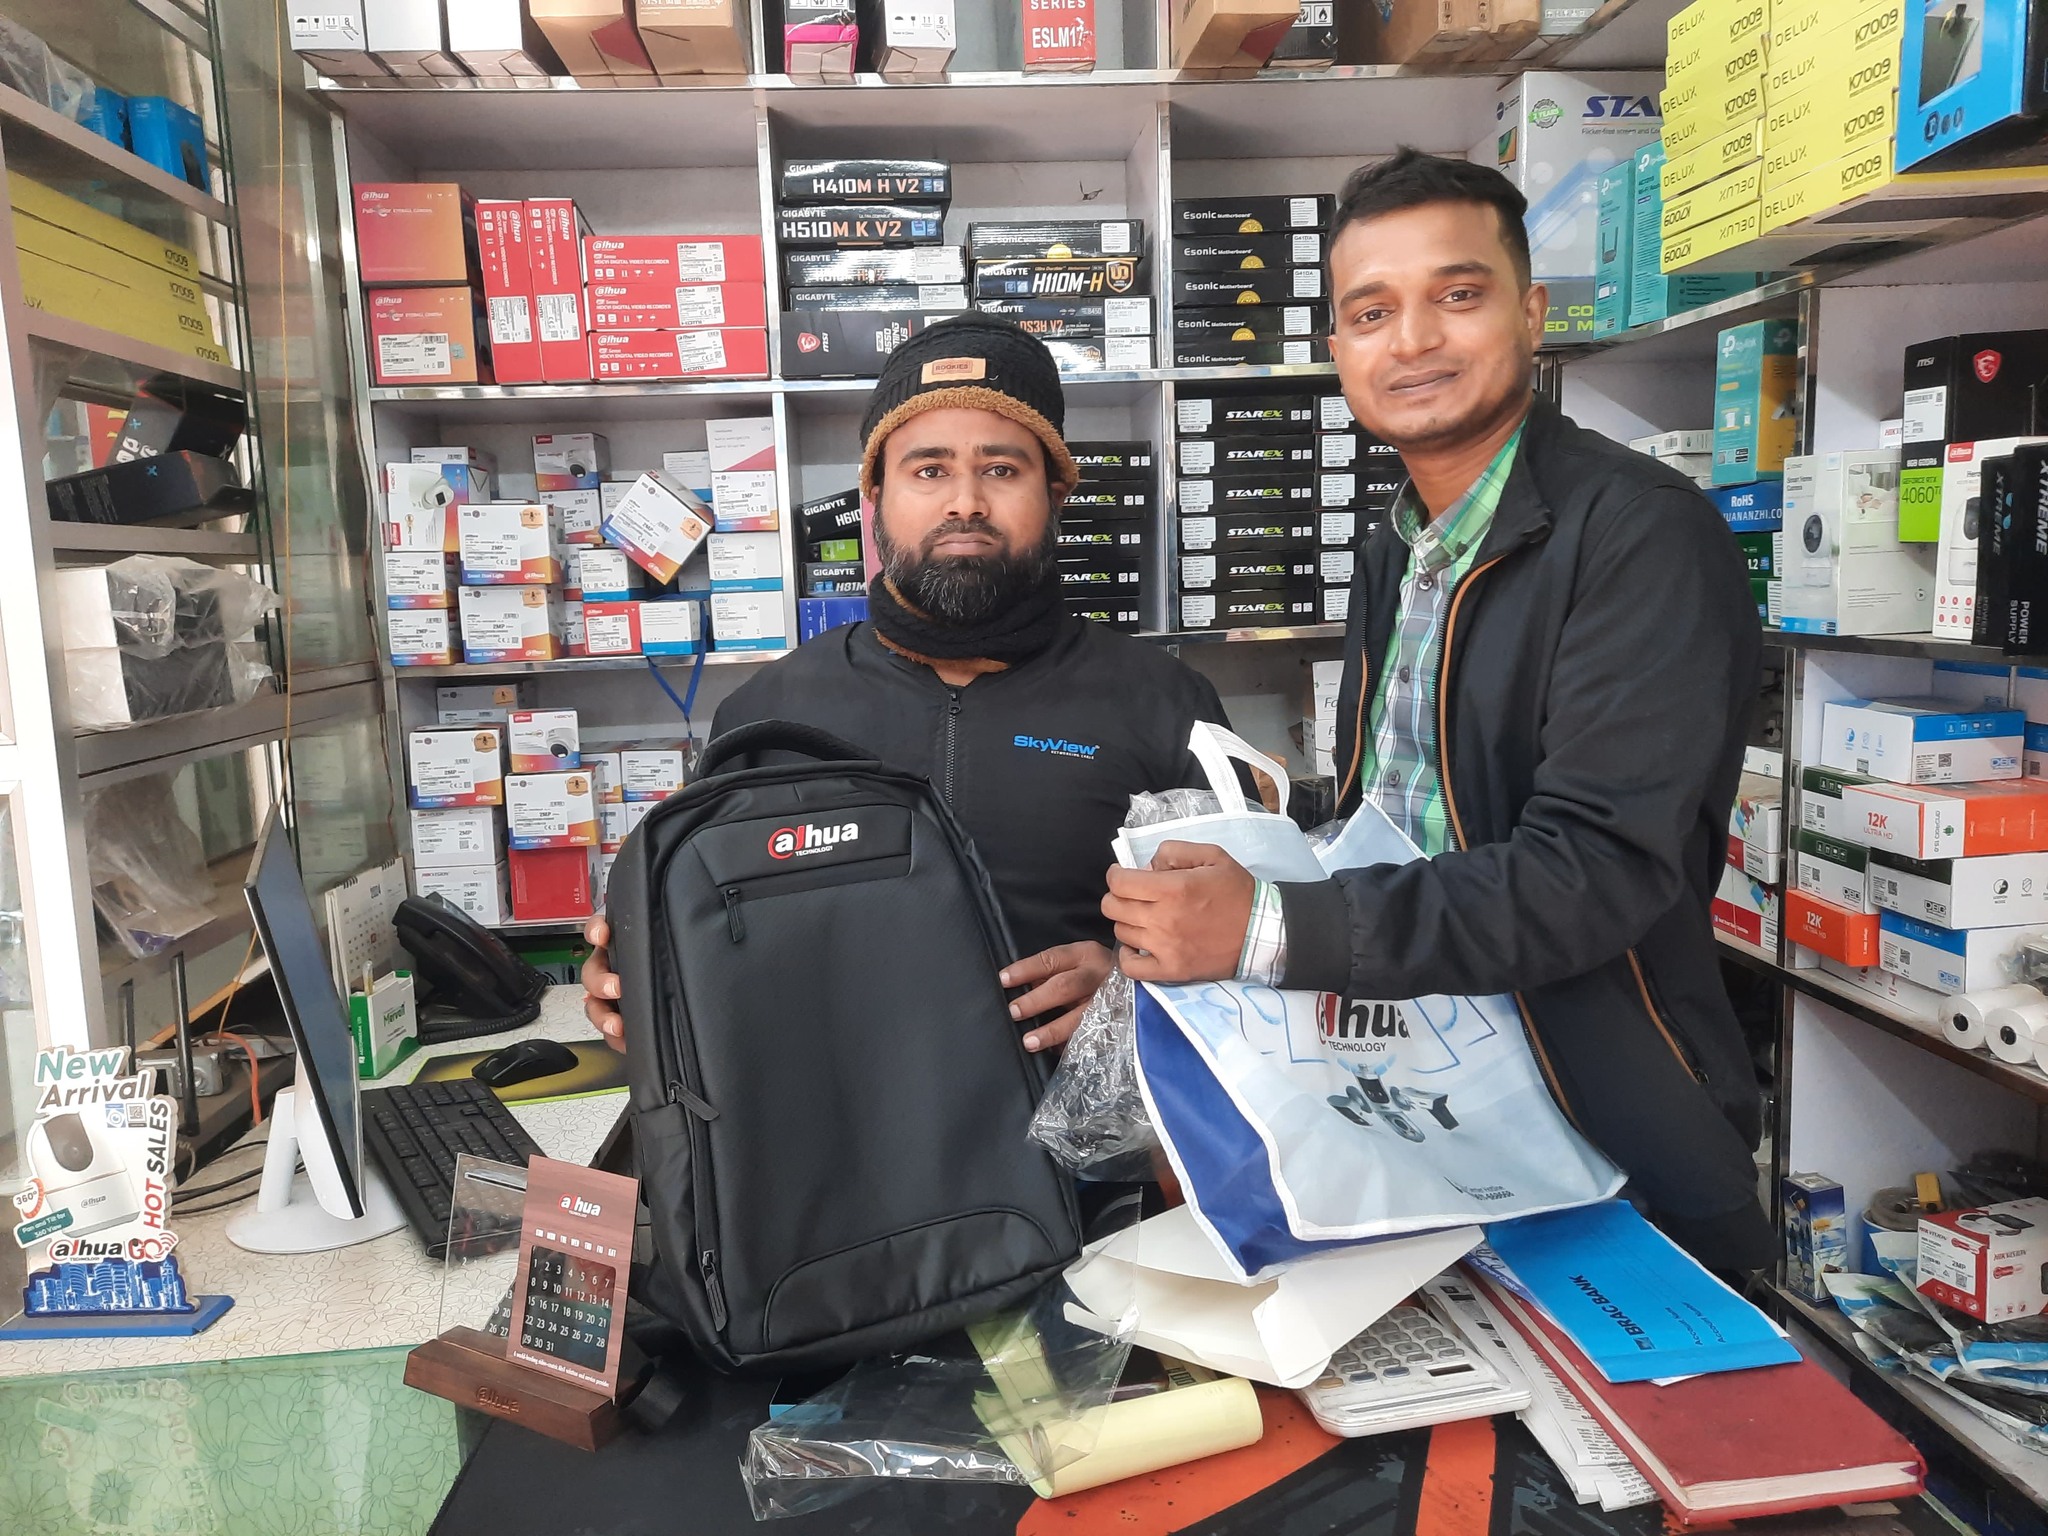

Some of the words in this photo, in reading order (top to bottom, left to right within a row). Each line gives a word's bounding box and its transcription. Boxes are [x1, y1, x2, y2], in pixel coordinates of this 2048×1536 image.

[1031, 0, 1085, 10] SERIES
[1671, 10, 1705, 40] DELUX
[1775, 11, 1819, 47] DELUX
[1667, 48, 1701, 78] DELUX
[1729, 7, 1763, 39] K7009
[1773, 56, 1816, 89] DELUX
[1855, 8, 1899, 44] K7009
[1663, 86, 1697, 114] DELUX
[1725, 49, 1758, 77] K7009
[1770, 101, 1811, 132] DELUX
[1849, 58, 1891, 91] K7009
[1582, 96, 1662, 117] STA
[1664, 122, 1697, 148] DELUX
[1724, 88, 1757, 116] K7009
[1767, 145, 1808, 174] DELUX
[1844, 105, 1885, 137] K7009
[1664, 164, 1695, 187] DELUX
[1722, 132, 1752, 157] K7009
[813, 179, 871, 193] H410M
[878, 179, 890, 193] H
[896, 179, 919, 193] V2
[1719, 175, 1755, 201] DELUX
[1764, 191, 1805, 218] DELUX
[1841, 155, 1882, 184] K7009
[782, 210, 826, 218] GIGABYTE
[1183, 211, 1216, 219] Esonic
[1664, 205, 1692, 227] K7009
[782, 221, 848, 238] H510M
[856, 221, 868, 237] K
[875, 221, 901, 237] V2
[1719, 215, 1755, 240] DELUX
[791, 254, 831, 262] GIGABYTE
[1184, 248, 1217, 256] Esonic
[1664, 242, 1692, 264] K7009
[984, 268, 1028, 276] GIGABYTE
[1032, 272, 1104, 292] H110M-H
[1185, 282, 1218, 290] Esonic
[796, 293, 836, 301] GIGABYTE
[981, 305, 1024, 313] GIGABYTE
[1020, 320, 1047, 333] DS3H
[1050, 320, 1063, 332] V2
[1178, 320, 1210, 328] Esonic
[935, 363, 968, 371] ROOKIES
[1178, 355, 1210, 363] Esonic
[1917, 357, 1935, 368] msi
[1226, 410, 1283, 419] STAREX
[1227, 449, 1284, 459] STAREX
[1226, 488, 1283, 498] STAREX
[1731, 494, 1754, 507] RoHS
[1902, 487, 1934, 504] 4060
[804, 498, 846, 516] GIGABYTE
[1993, 471, 2004, 555] XTREME
[2035, 459, 2048, 555] XTREME
[1227, 527, 1284, 537] STAREX
[1229, 565, 1286, 575] STAREX
[835, 582, 866, 592] H81M
[1228, 603, 1284, 613] STAREX
[2008, 600, 2017, 644] SUPPLY
[2018, 601, 2030, 645] POWER
[1014, 735, 1096, 755] SkyView
[1868, 812, 1888, 829] 12K
[1864, 827, 1882, 837] ULTRA
[1883, 832, 1893, 840] HD
[795, 845, 833, 856] TECHNOLOGY
[1807, 911, 1822, 928] 12K
[1328, 1040, 1387, 1052] TECHNOLOGY
[37, 1052, 122, 1083] New
[40, 1074, 148, 1109] Arrival
[148, 1101, 169, 1175] SALES
[143, 1178, 164, 1229] HOT
[22, 1225, 35, 1234] Pan
[35, 1221, 47, 1230] and
[57, 1213, 66, 1221] for
[34, 1230, 47, 1239] 360
[48, 1224, 61, 1233] View
[534, 1259, 537, 1267] 1
[545, 1262, 549, 1271] 2
[556, 1265, 561, 1274] 3
[569, 1269, 573, 1277] 4
[581, 1272, 585, 1281] 5
[592, 1276, 597, 1285] 6
[605, 1279, 609, 1288] 7
[1952, 1260, 1966, 1270] 2MP
[531, 1277, 536, 1286] 8
[543, 1281, 548, 1290] 9
[553, 1284, 561, 1294] 10
[565, 1288, 572, 1296] 11
[577, 1291, 585, 1301] 12
[589, 1294, 597, 1304] 13
[602, 1298, 609, 1308] 14
[1568, 1274, 1610, 1305] BANK
[528, 1296, 535, 1306] 15
[540, 1300, 547, 1309] 16
[551, 1303, 559, 1312] 17
[563, 1307, 571, 1317] 18
[575, 1310, 583, 1320] 19
[586, 1314, 595, 1324] 20
[598, 1317, 606, 1328] 21
[1602, 1304, 1645, 1336] BRAC
[489, 1323, 497, 1333] 26
[500, 1327, 508, 1337] 27
[525, 1315, 534, 1325] 22
[537, 1319, 545, 1328] 23
[548, 1322, 557, 1332] 24
[560, 1326, 569, 1336] 25
[572, 1330, 580, 1340] 26
[584, 1333, 593, 1343] 27
[596, 1337, 605, 1348] 28
[1679, 1319, 1703, 1346] Account
[1701, 1317, 1726, 1343] Account
[534, 1338, 543, 1348] 30
[546, 1341, 554, 1351] 31
